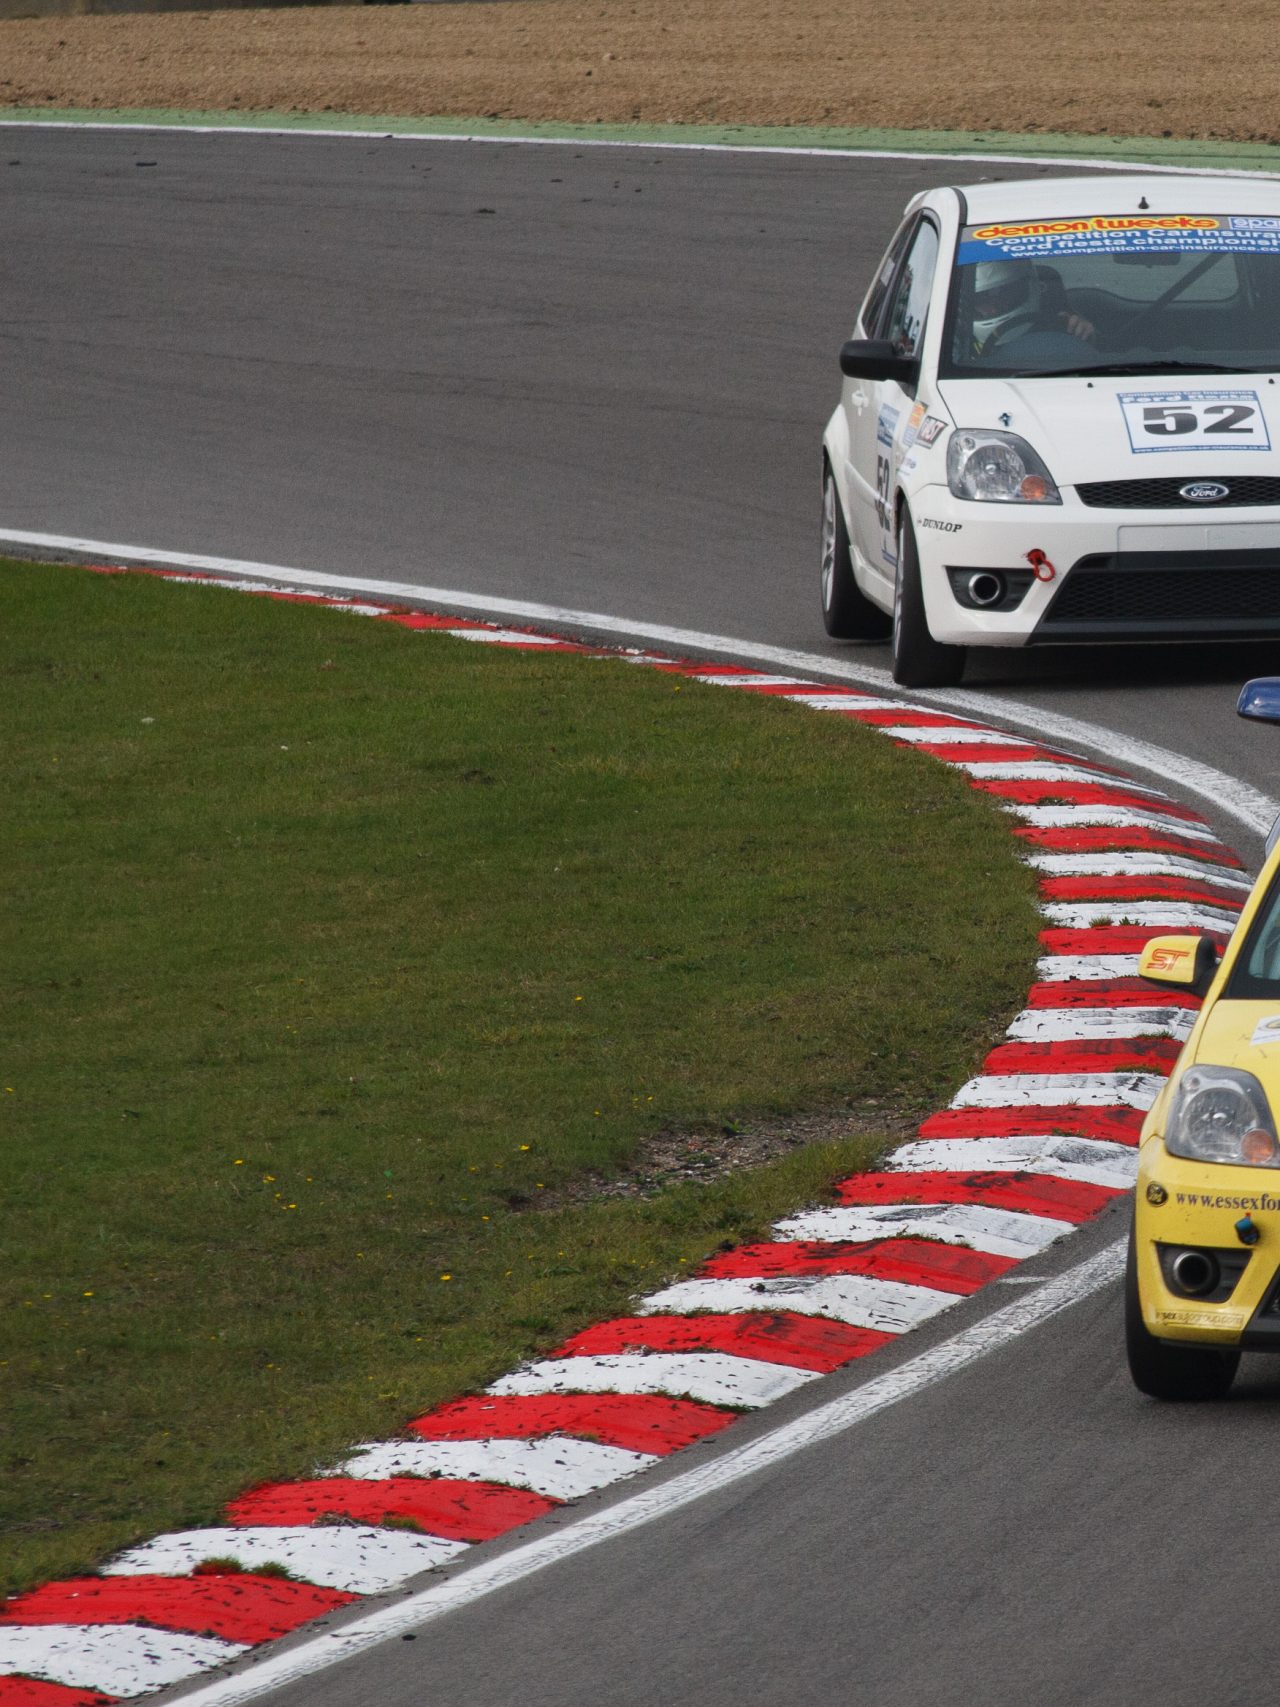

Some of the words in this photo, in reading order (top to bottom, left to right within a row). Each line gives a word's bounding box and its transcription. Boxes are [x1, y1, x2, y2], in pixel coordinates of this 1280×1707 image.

[974, 219, 1091, 239] demon
[1090, 216, 1218, 230] tweeks
[986, 230, 1141, 246] Competition
[1147, 229, 1192, 237] Car
[1001, 239, 1052, 252] ford
[1058, 238, 1126, 248] fiesta
[1143, 405, 1255, 435] 52
[922, 518, 963, 533] DUNLOP
[1146, 948, 1190, 971] ST
